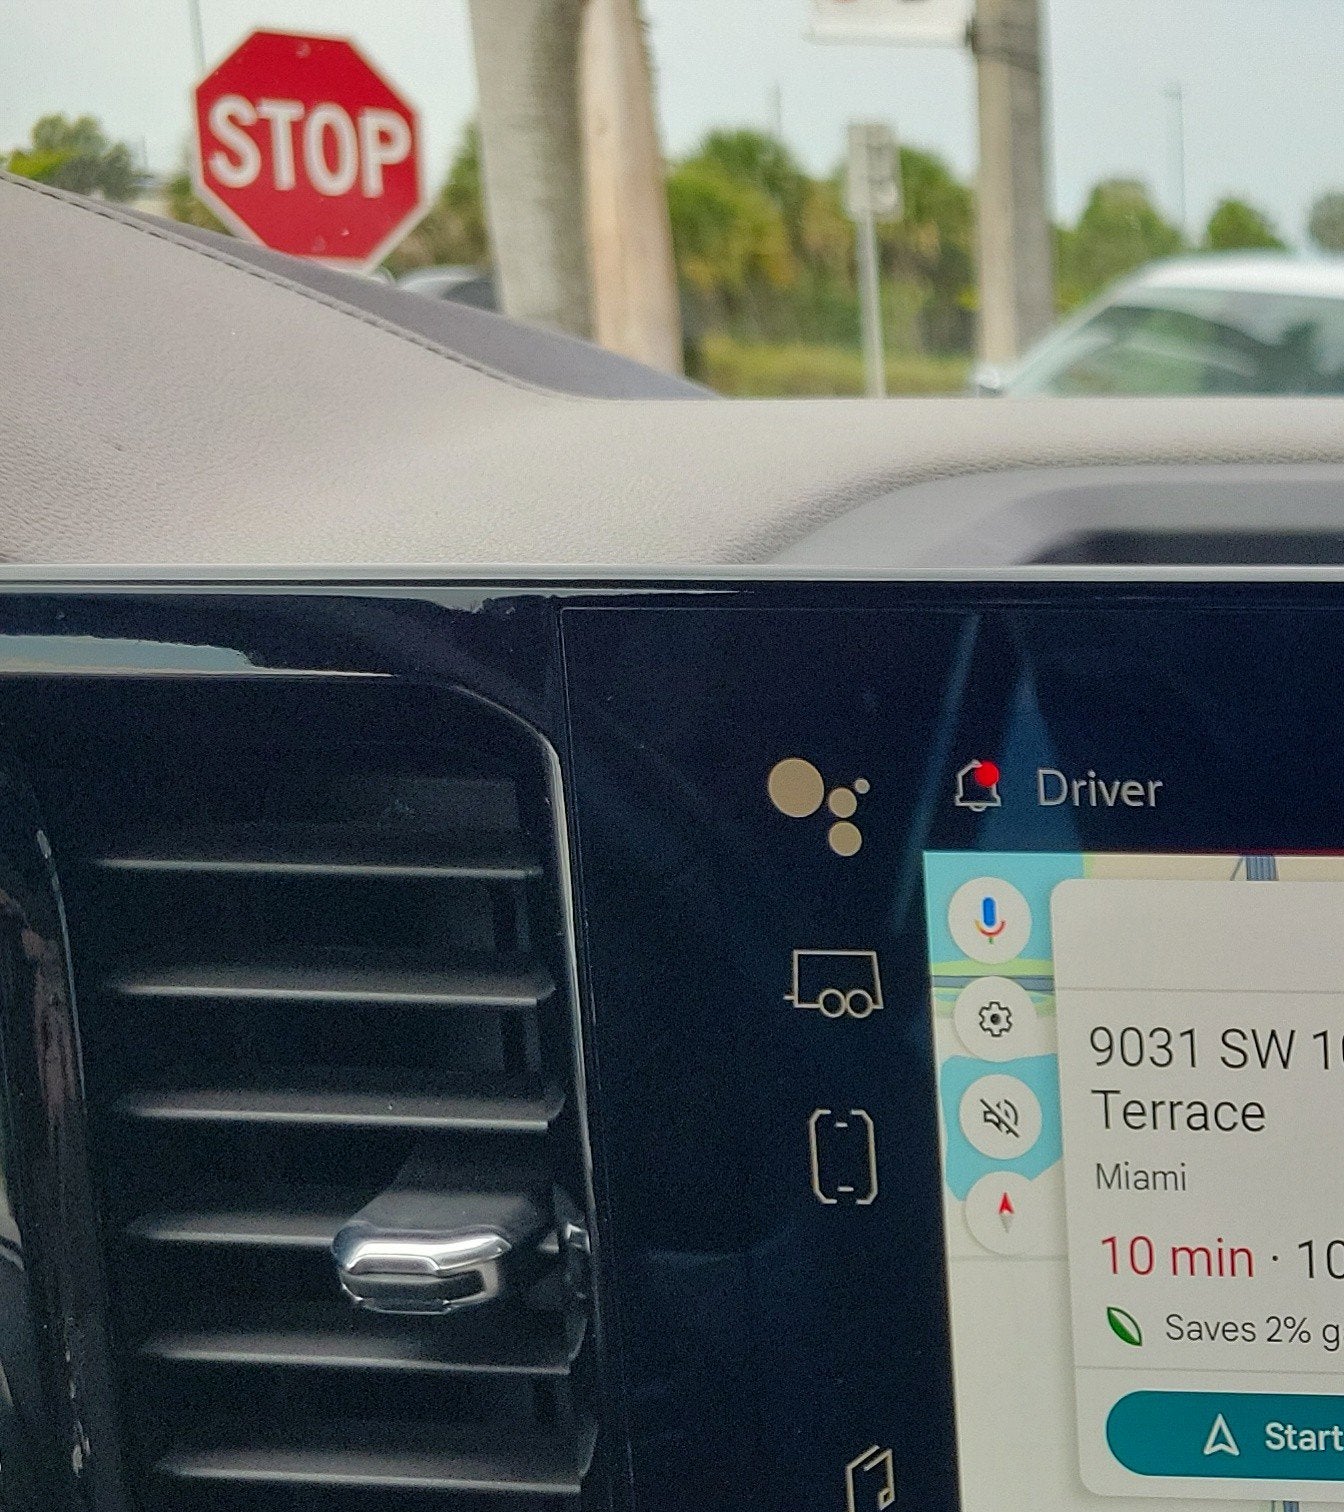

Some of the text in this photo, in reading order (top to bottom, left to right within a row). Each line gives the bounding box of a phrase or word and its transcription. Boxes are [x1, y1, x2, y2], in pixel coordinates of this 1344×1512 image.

[209, 93, 411, 198] STOP
[1037, 769, 1163, 808] Driver
[1089, 1026, 1199, 1069] 9031
[1220, 1028, 1295, 1071] SW
[1092, 1089, 1267, 1132] Terrace
[1096, 1162, 1187, 1192] Miami
[1101, 1235, 1155, 1276] 10
[1171, 1237, 1255, 1279] min
[1165, 1315, 1257, 1343] Saves
[1265, 1315, 1312, 1345] 2%
[1265, 1422, 1344, 1453] Start
